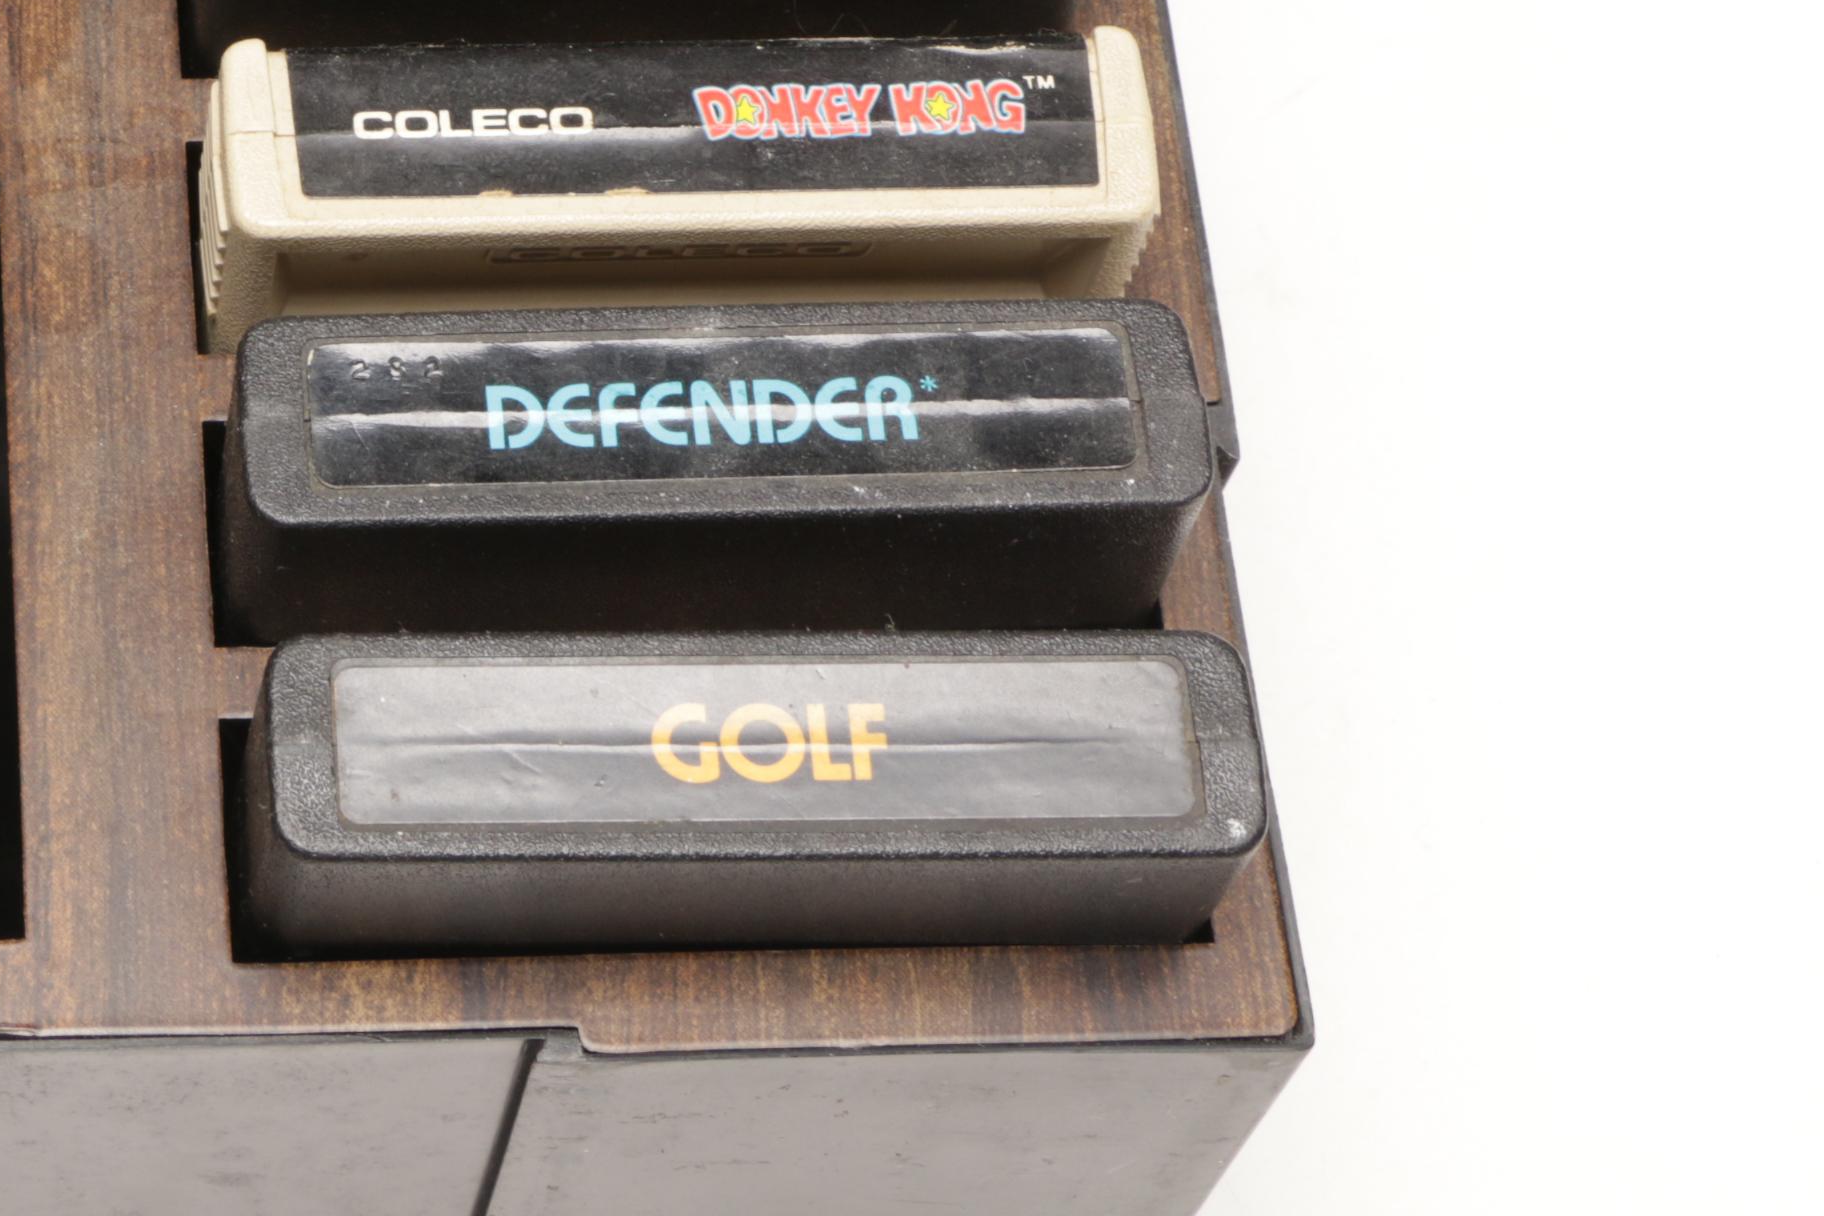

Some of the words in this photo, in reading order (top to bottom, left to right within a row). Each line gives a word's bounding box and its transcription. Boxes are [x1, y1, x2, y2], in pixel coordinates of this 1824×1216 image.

[353, 105, 594, 139] COLECO
[693, 82, 879, 140] DONKEY
[650, 703, 888, 783] GOLF
